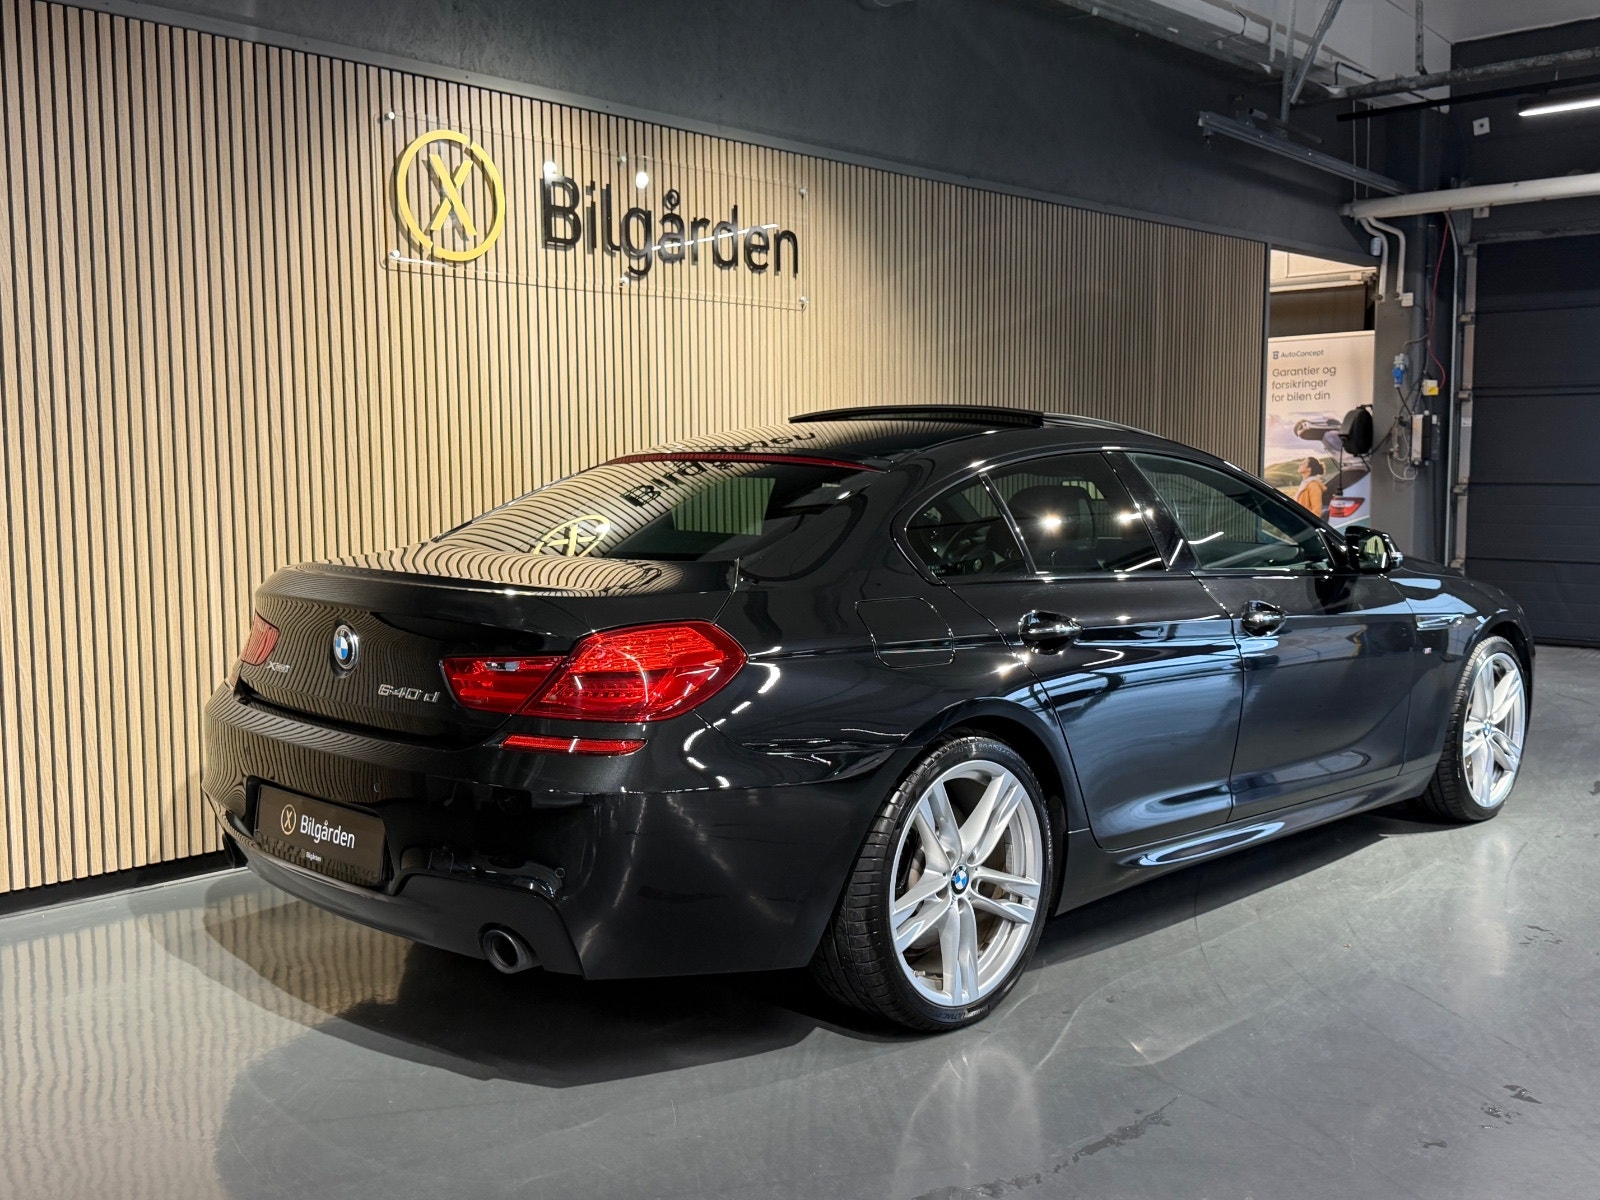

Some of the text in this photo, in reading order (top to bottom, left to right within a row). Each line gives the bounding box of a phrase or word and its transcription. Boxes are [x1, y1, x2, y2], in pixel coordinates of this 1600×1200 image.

[542, 175, 799, 277] Bilgården
[1281, 350, 1324, 358] AutoConcept
[1272, 366, 1336, 377] Garantier og
[1272, 379, 1328, 390] forsikringer
[1272, 391, 1331, 402] for bilen din
[300, 814, 355, 849] Bilgården
